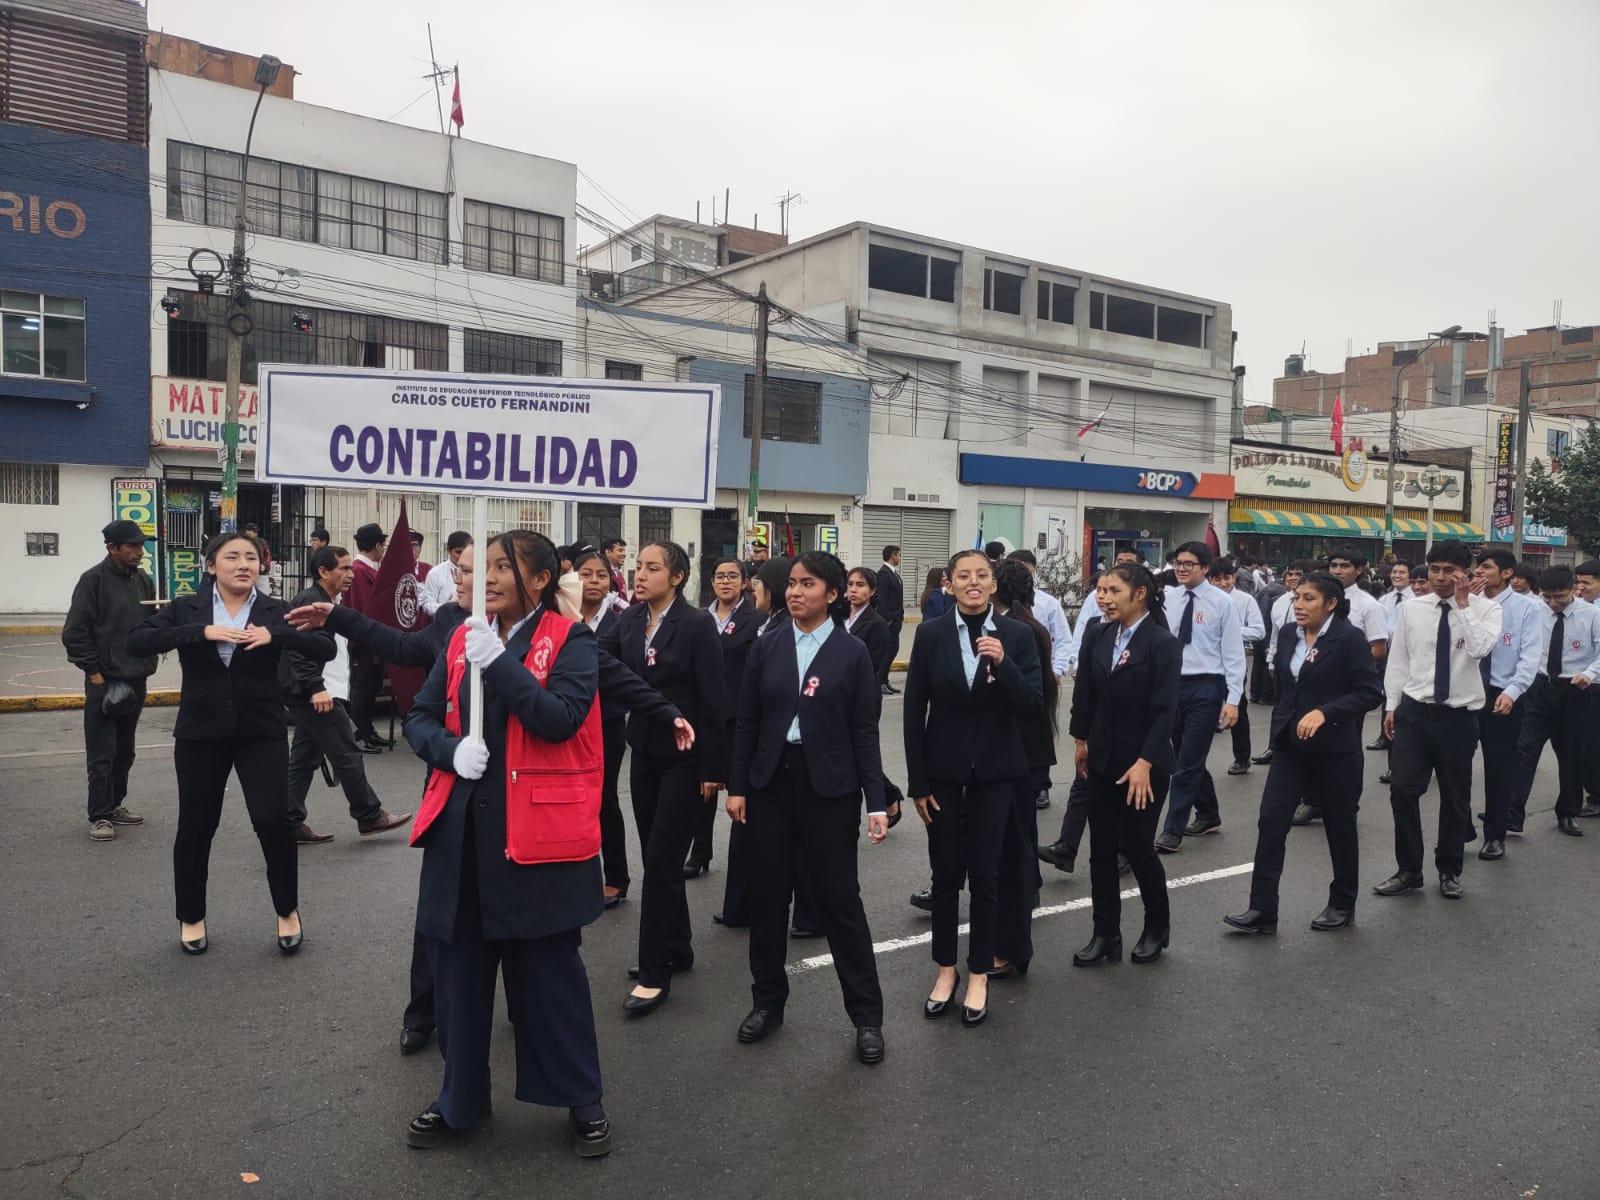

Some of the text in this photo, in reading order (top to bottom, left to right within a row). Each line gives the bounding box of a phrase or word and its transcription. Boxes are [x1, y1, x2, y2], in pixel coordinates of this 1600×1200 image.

[392, 393, 590, 413] CARLOS CUETO FERNANDINI
[562, 392, 590, 400] PÚBLICO
[1499, 424, 1510, 465] PRIVATE
[329, 424, 638, 489] CONTABILIDAD
[1147, 472, 1175, 490] BCP
[1498, 479, 1507, 487] 25
[1497, 490, 1507, 498] 30
